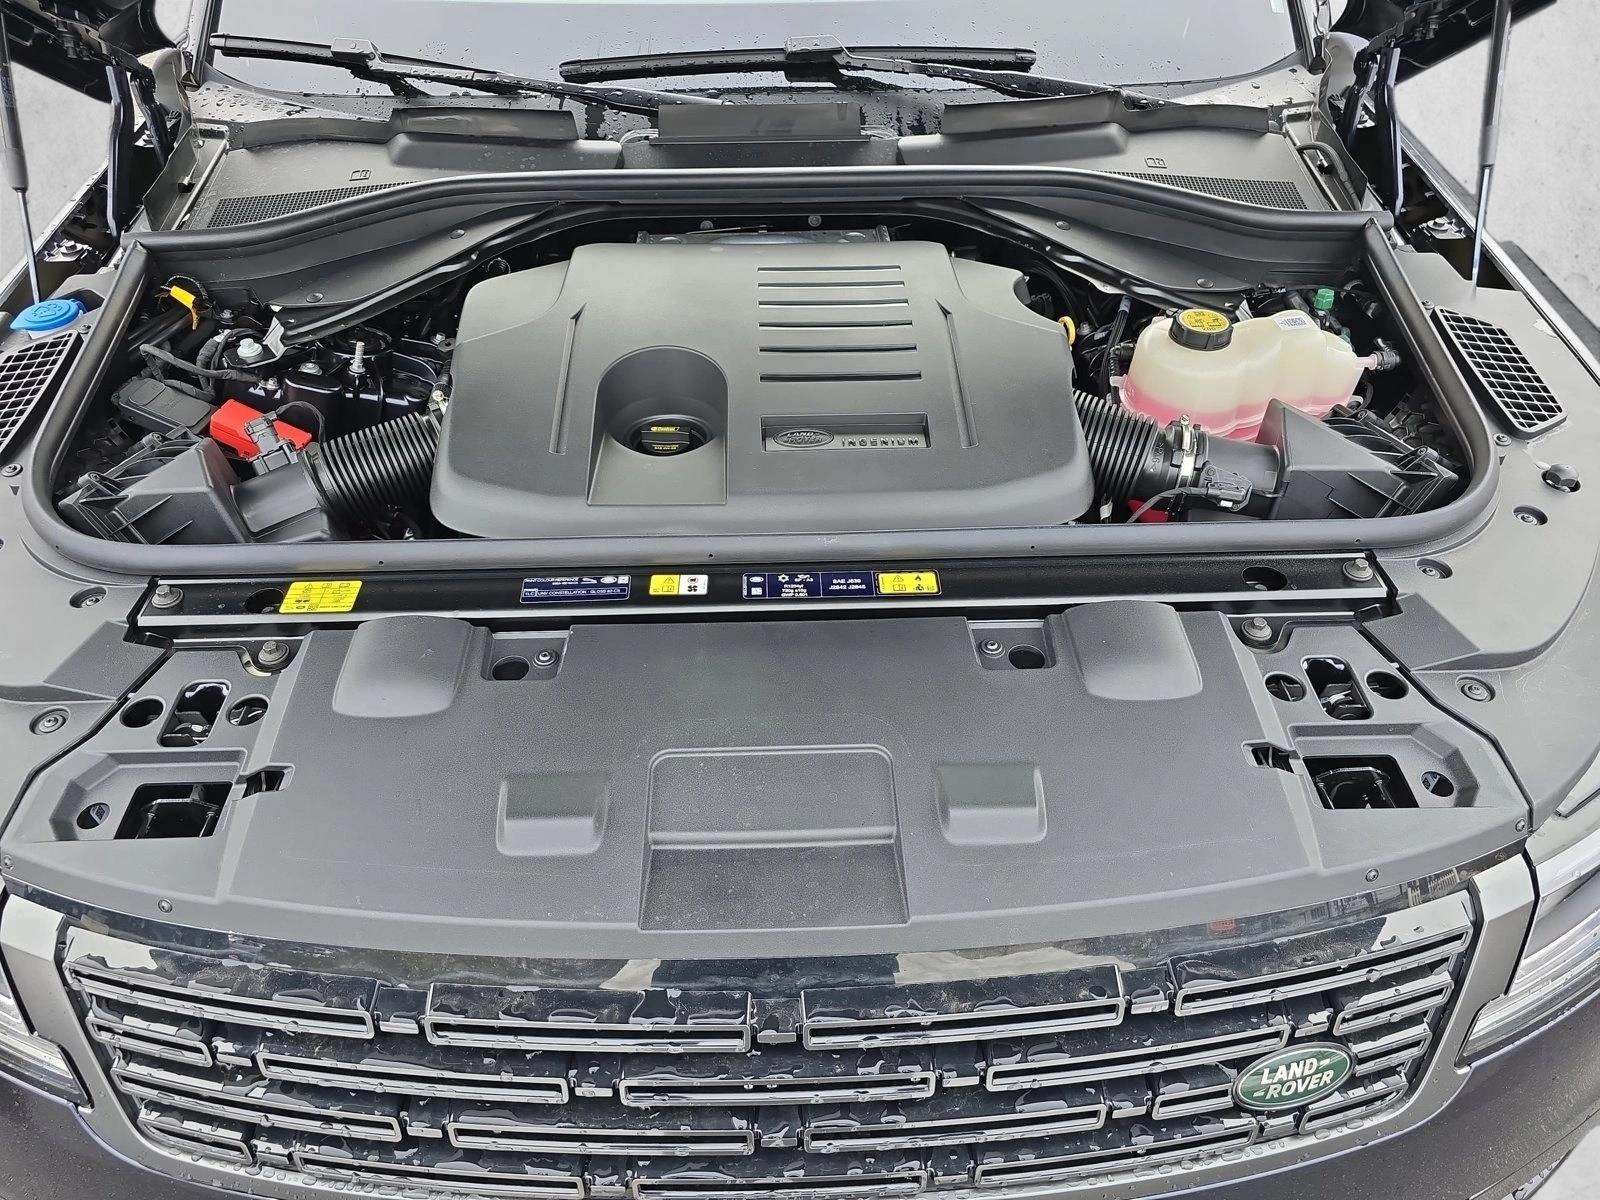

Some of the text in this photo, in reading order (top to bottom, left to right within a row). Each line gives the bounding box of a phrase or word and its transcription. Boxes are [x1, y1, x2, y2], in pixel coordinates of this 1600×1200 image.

[841, 437, 919, 447] INGENIUM
[1260, 1057, 1318, 1085] LAND
[1265, 1069, 1335, 1100] ROVER
